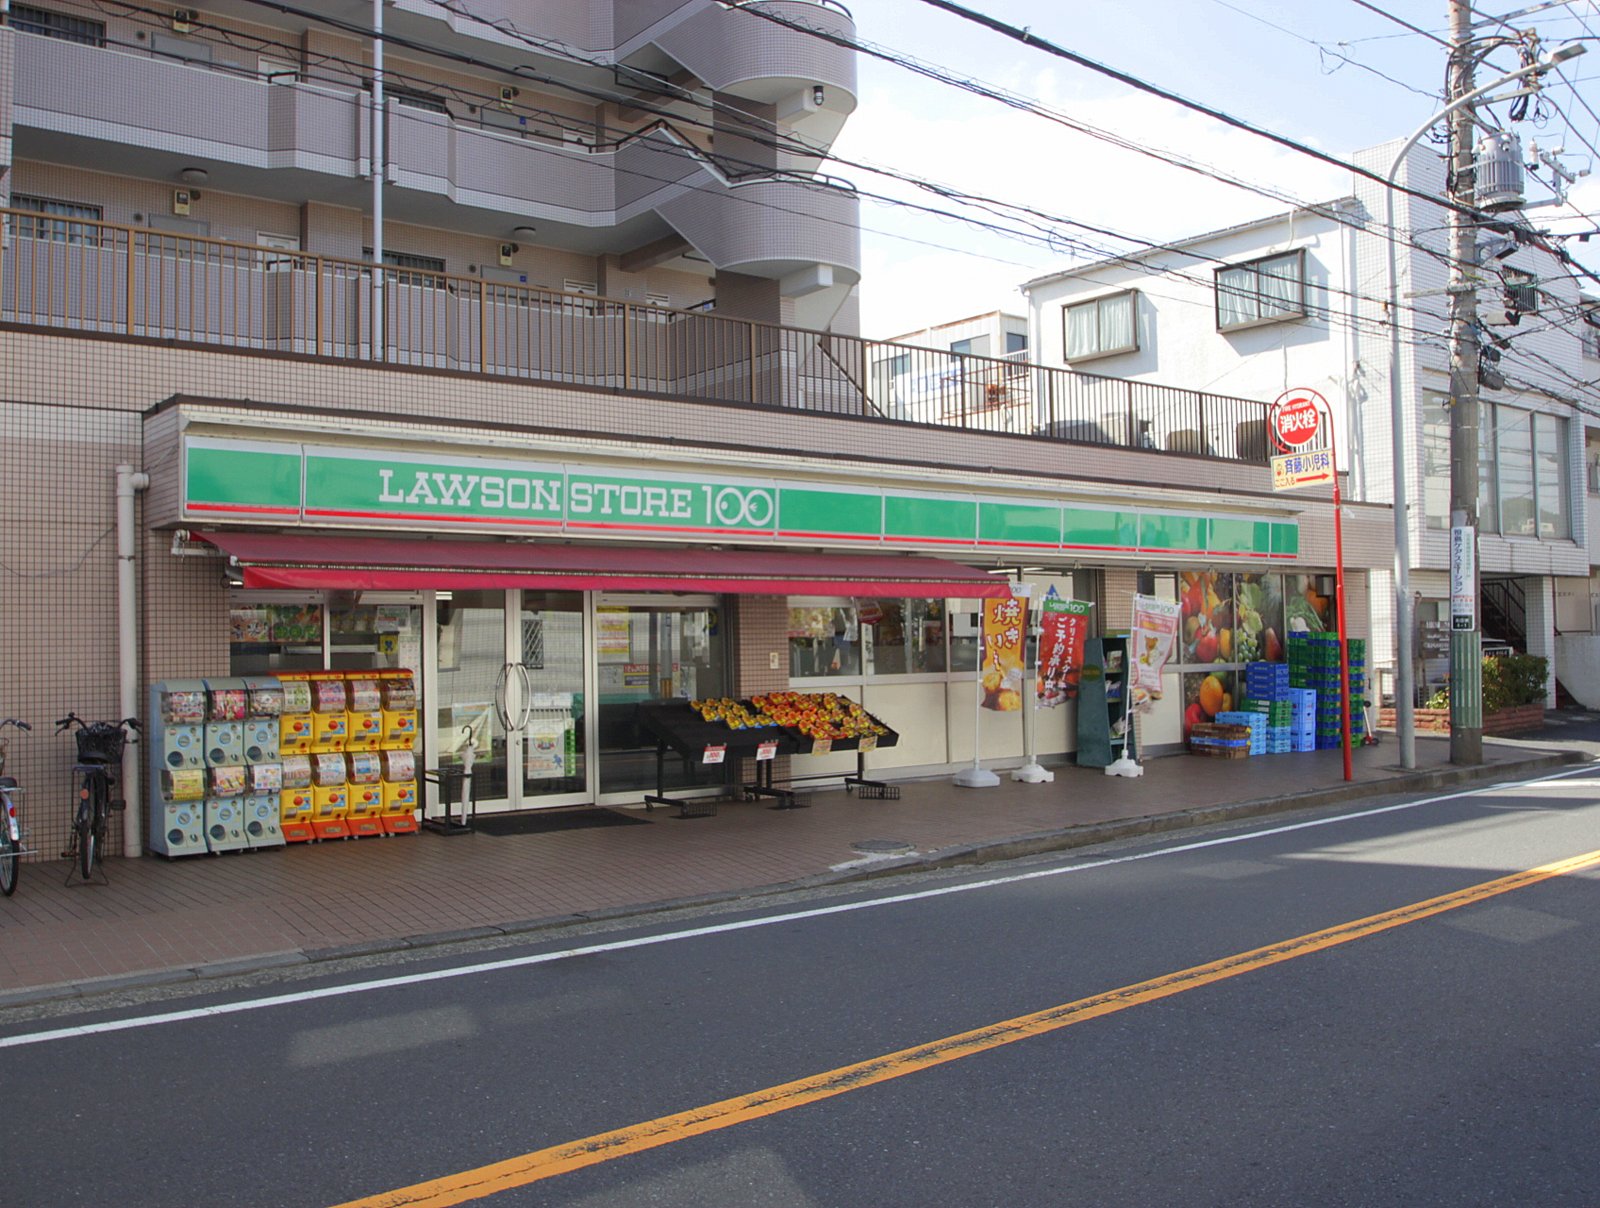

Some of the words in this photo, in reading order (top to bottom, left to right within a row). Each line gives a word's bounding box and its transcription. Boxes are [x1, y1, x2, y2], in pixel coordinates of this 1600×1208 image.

[1280, 409, 1315, 433] 消火栓
[378, 469, 561, 512] LAWSON
[570, 485, 692, 519] STORE
[702, 485, 774, 527] 100
